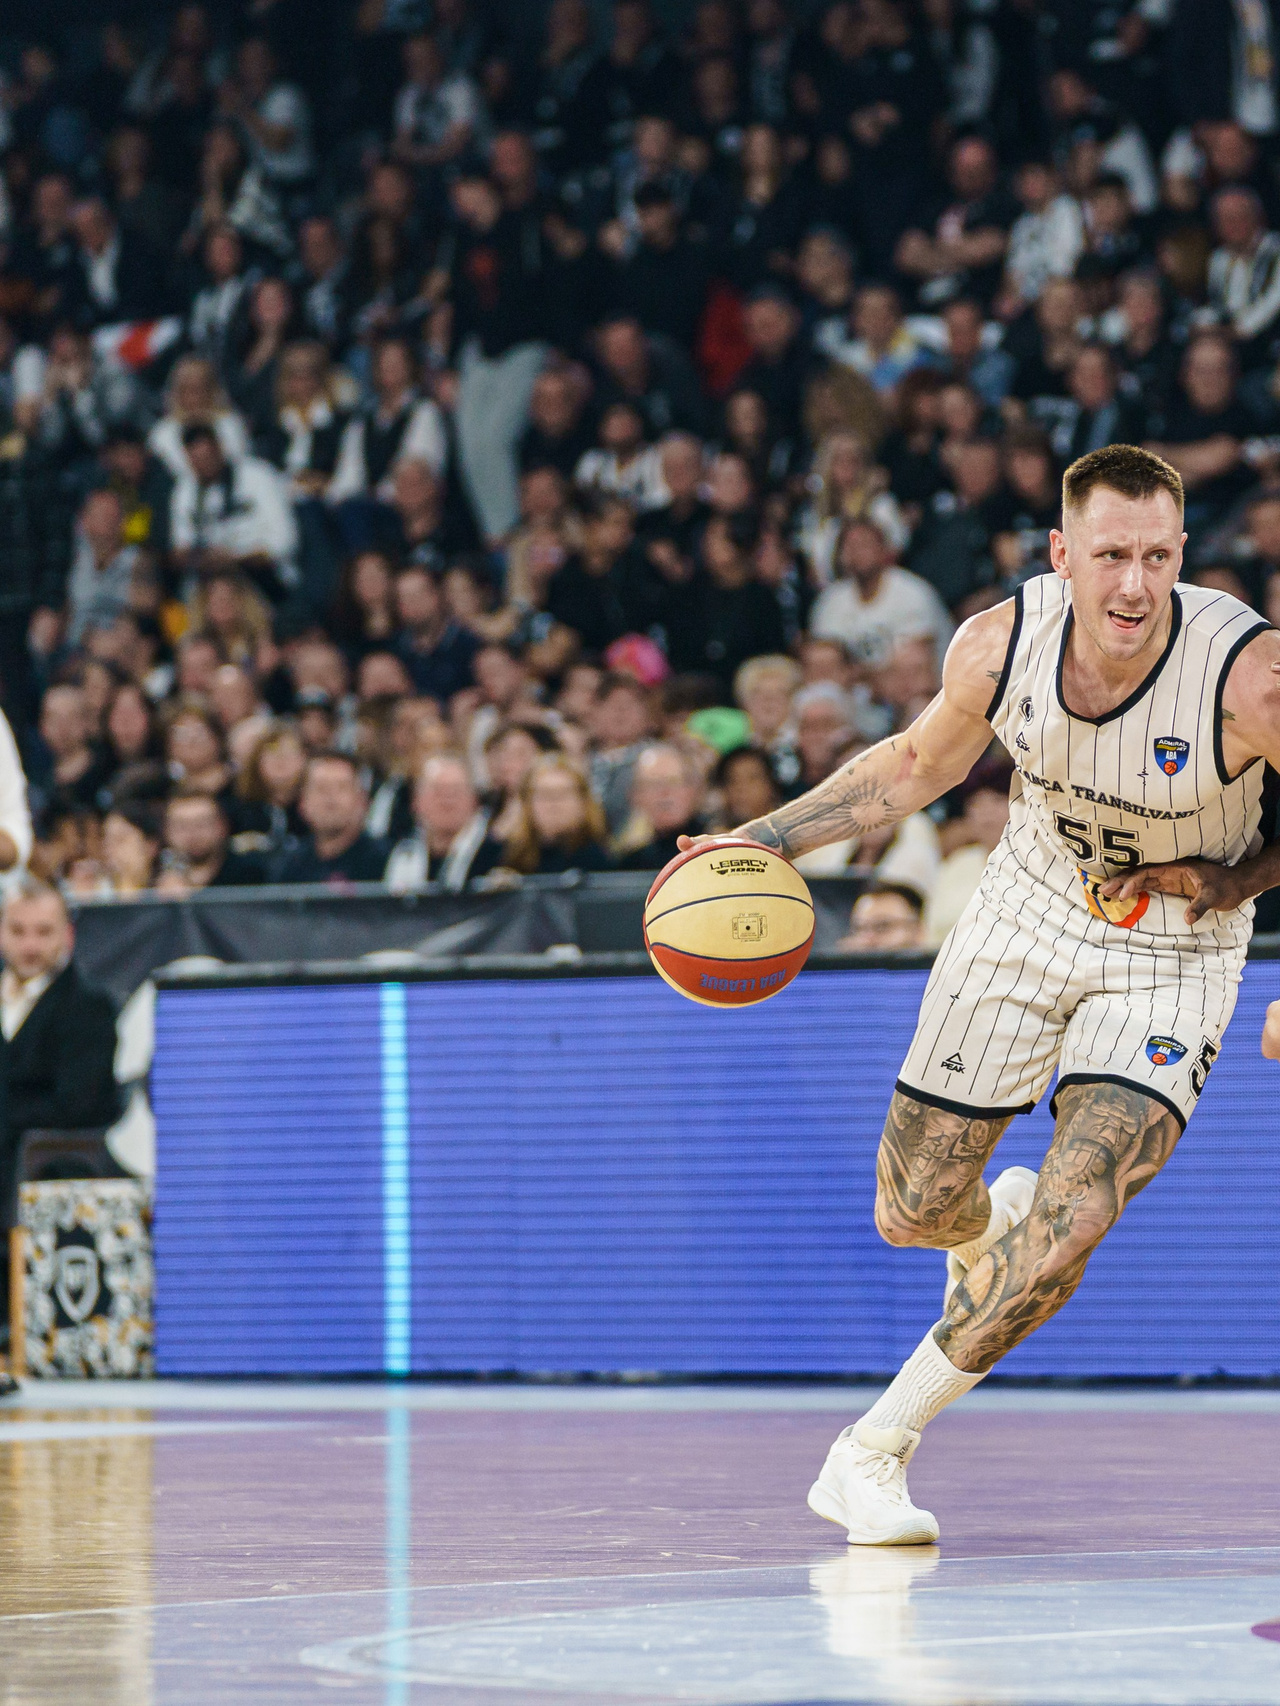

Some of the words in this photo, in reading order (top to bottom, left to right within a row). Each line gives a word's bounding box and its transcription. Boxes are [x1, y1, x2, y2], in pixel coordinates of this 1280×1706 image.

[1165, 750, 1178, 760] ABA
[1053, 811, 1144, 868] 55
[710, 859, 769, 870] LEGACY
[700, 973, 756, 992] LEAGUE
[760, 968, 787, 988] ABA
[1157, 1045, 1171, 1056] ABA
[941, 1061, 966, 1074] PEAK
